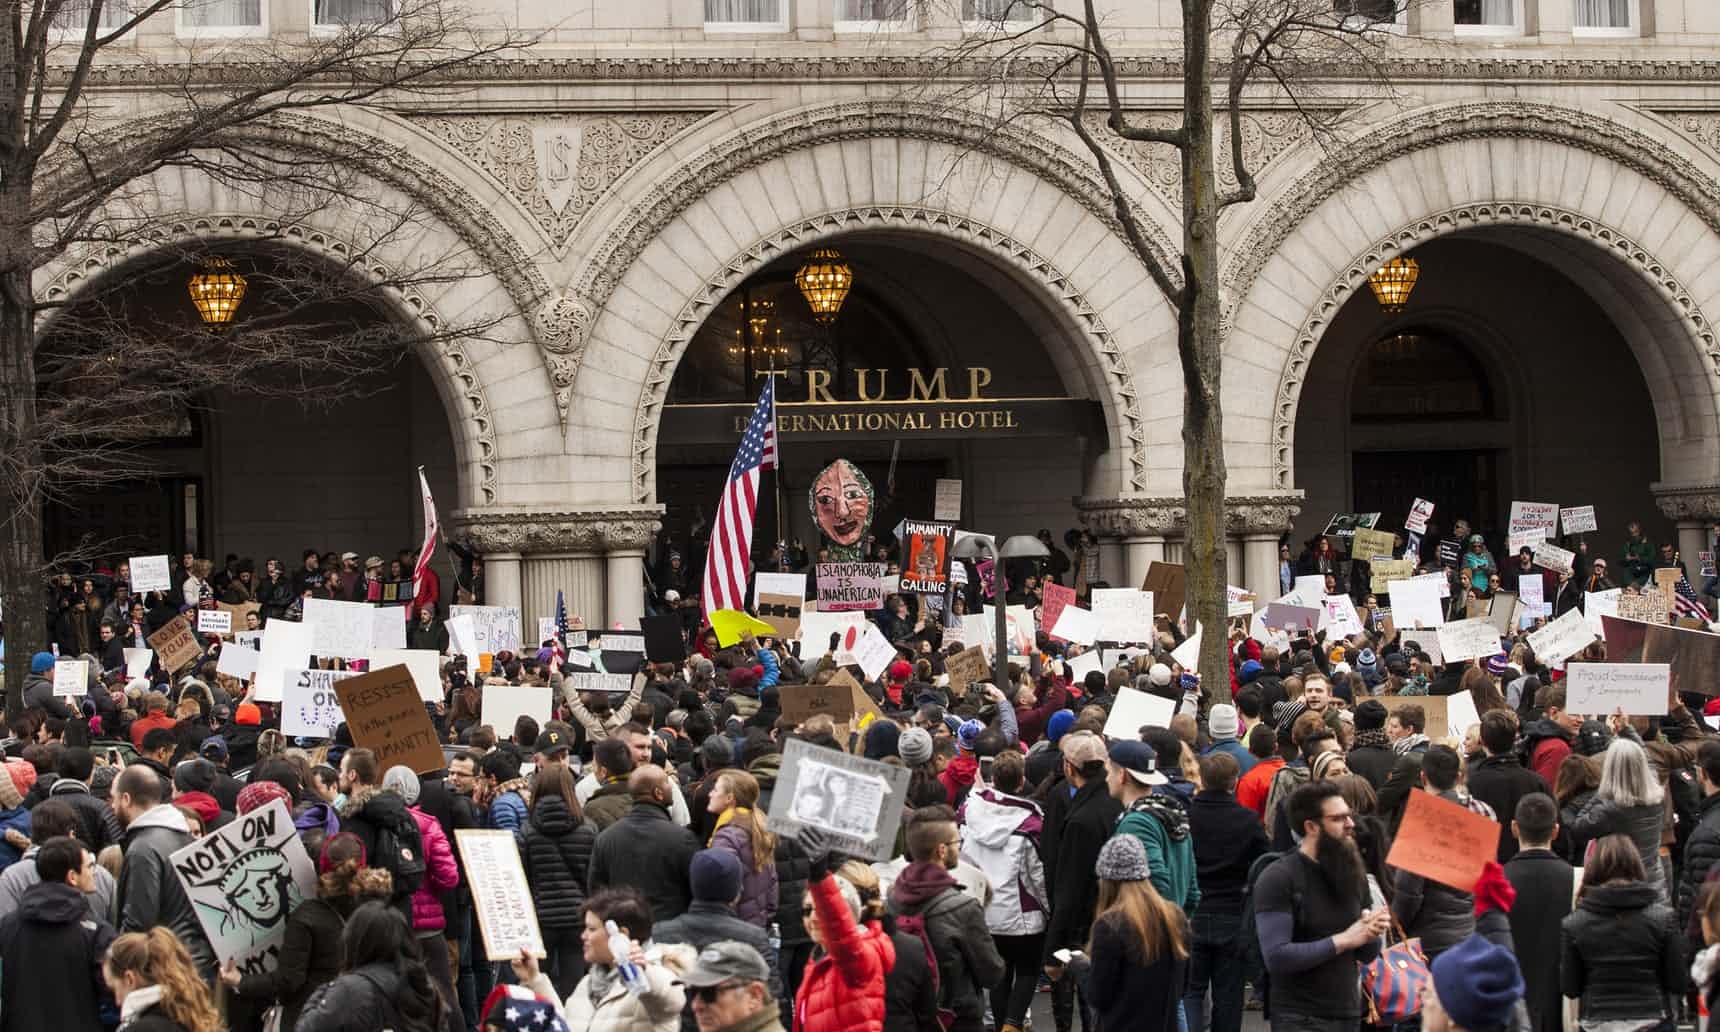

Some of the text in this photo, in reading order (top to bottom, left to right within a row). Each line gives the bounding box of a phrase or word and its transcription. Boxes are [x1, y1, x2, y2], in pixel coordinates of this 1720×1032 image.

[755, 367, 992, 401] TRUMP
[939, 410, 1018, 429] HOTEL
[905, 522, 952, 537] HUMANITY
[817, 563, 881, 578] ISLAMOPHOBIA
[838, 578, 852, 587] IS
[900, 578, 946, 593] CALLING
[817, 586, 881, 602] UNAMERICAN
[161, 632, 192, 659] YOUR
[346, 679, 414, 712] RESIST
[375, 729, 432, 762] UMANITY
[550, 733, 559, 744] P
[175, 809, 276, 888] NOT ON
